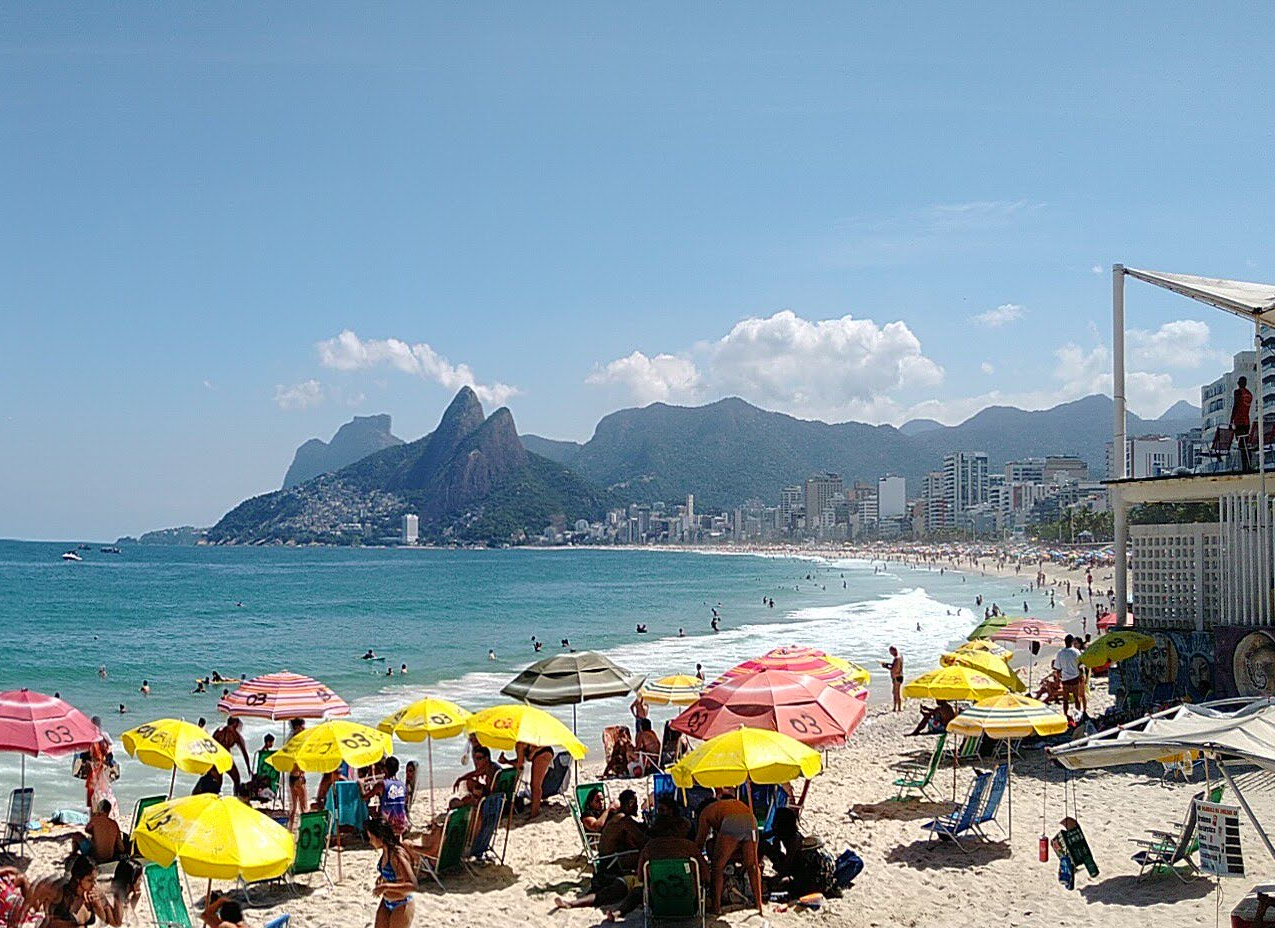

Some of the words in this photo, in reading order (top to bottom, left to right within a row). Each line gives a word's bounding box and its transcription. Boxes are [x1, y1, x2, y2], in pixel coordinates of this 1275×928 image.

[1107, 637, 1125, 648] 03
[246, 692, 267, 706] 03
[431, 713, 453, 725] 03
[790, 713, 822, 735] 03
[45, 725, 74, 744] 03
[341, 733, 371, 749] 03
[301, 824, 322, 849] 03
